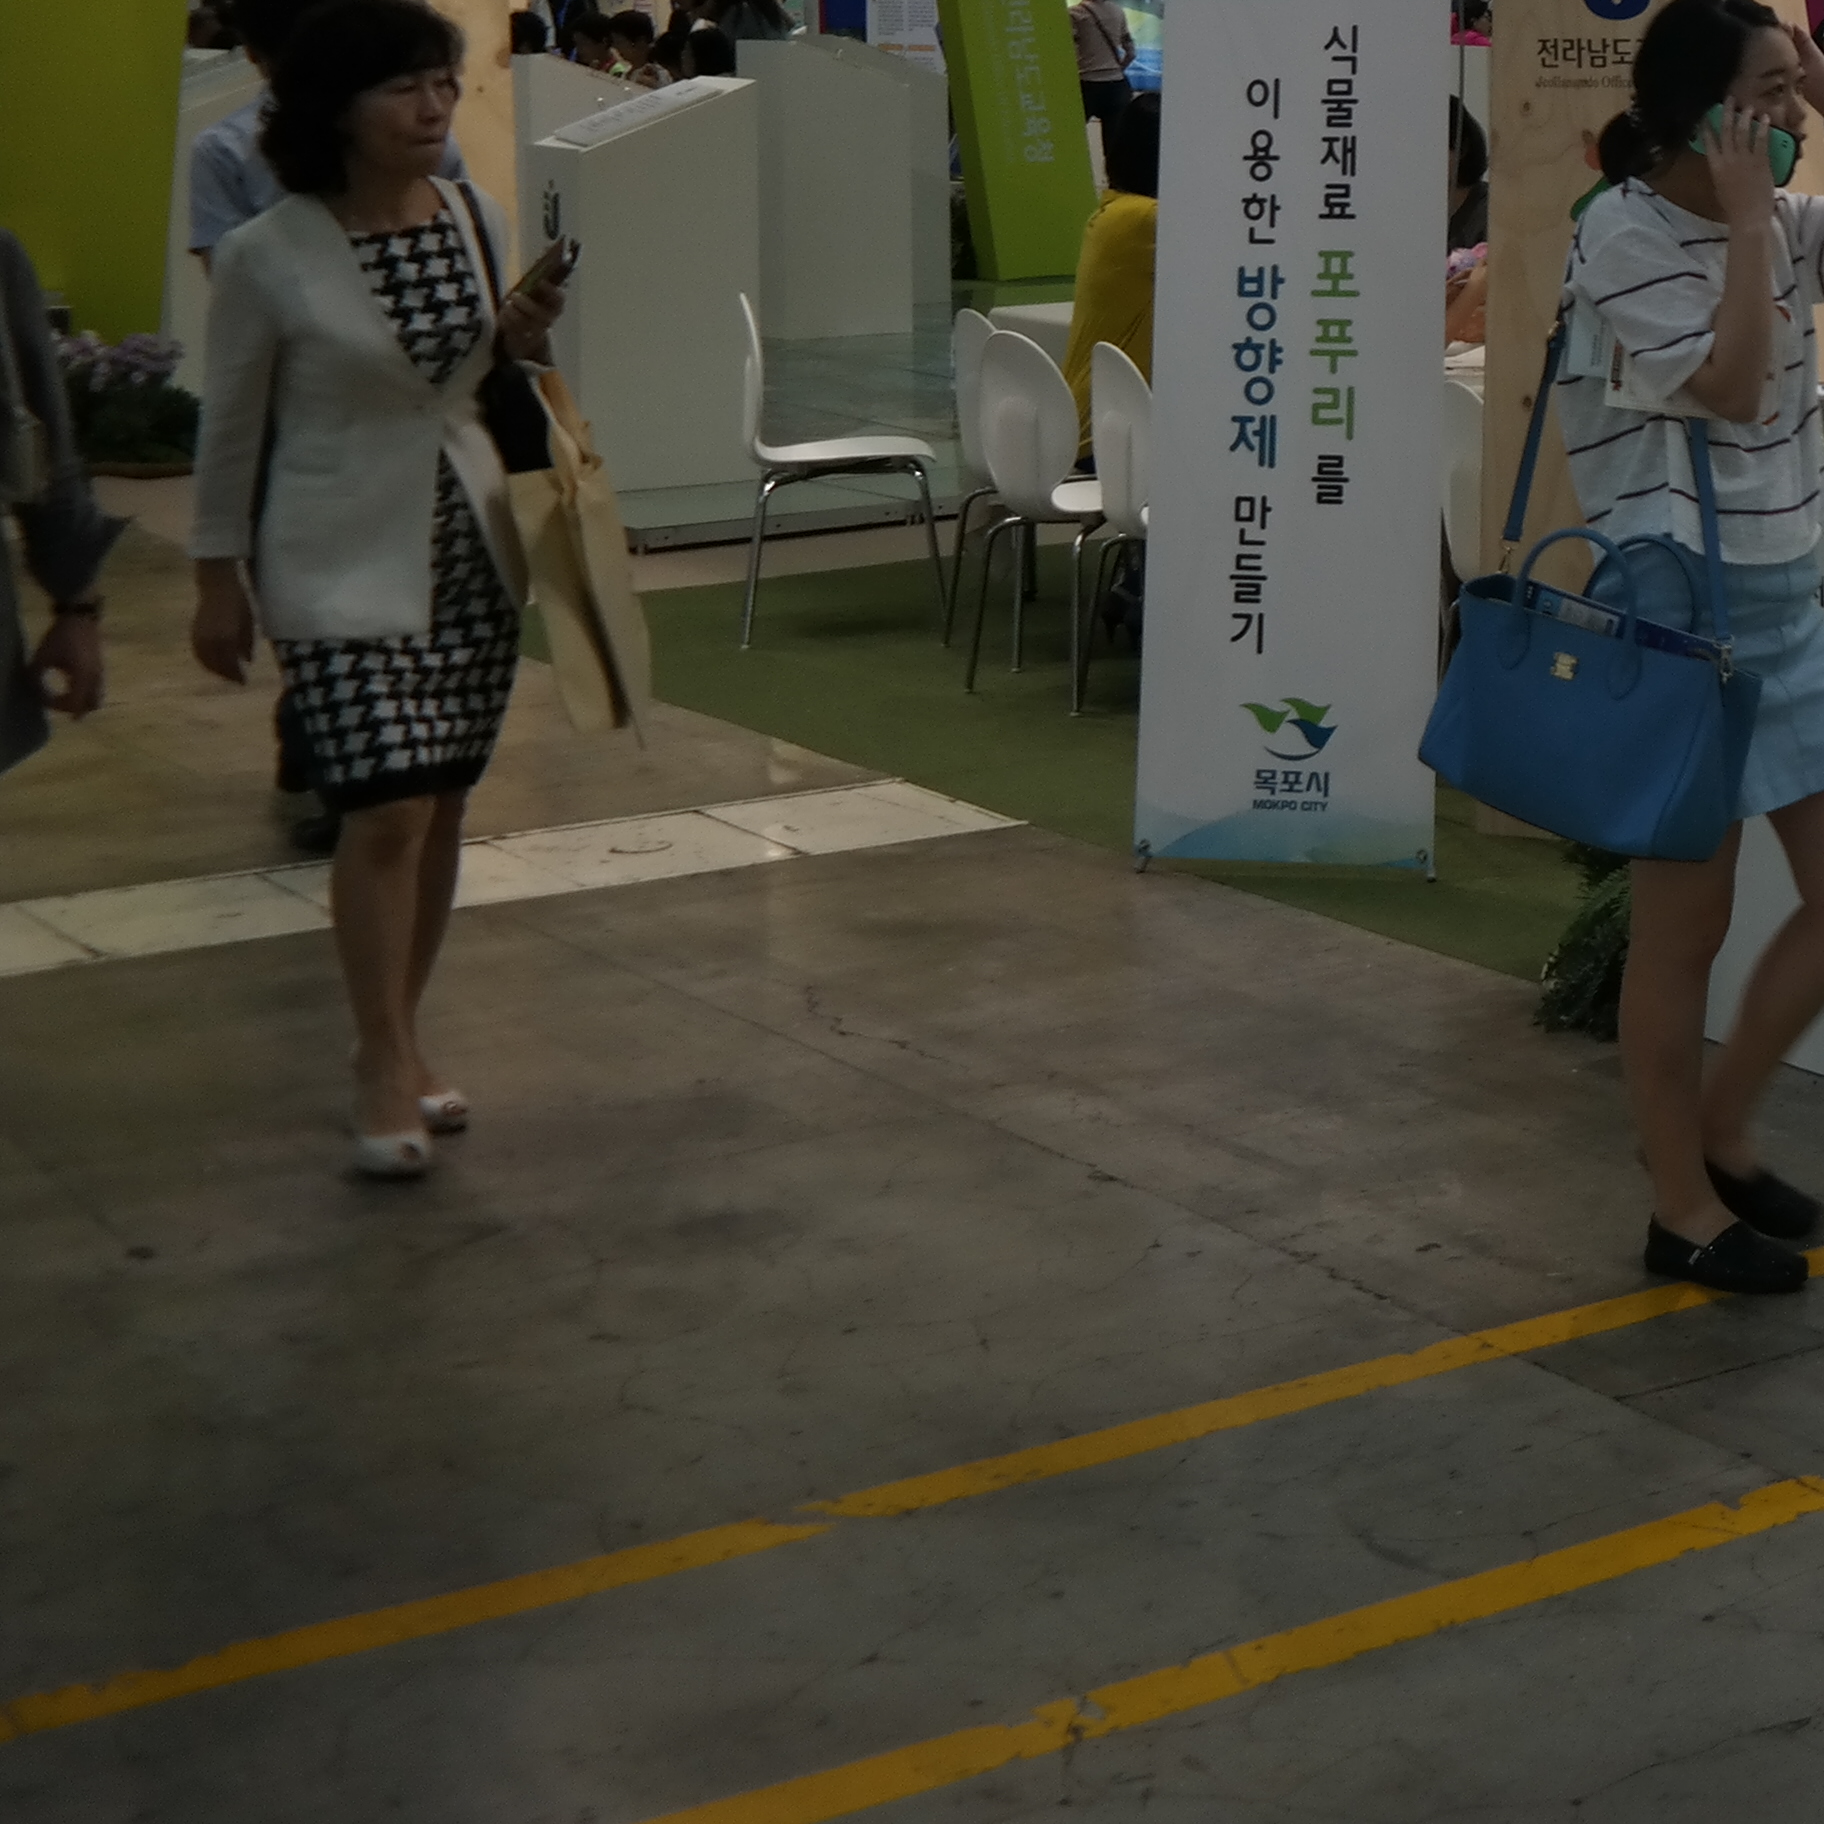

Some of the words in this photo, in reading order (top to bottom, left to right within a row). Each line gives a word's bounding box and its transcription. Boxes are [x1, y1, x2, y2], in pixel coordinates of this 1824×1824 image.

[1317, 24, 1359, 221] 식물재료
[1537, 37, 1646, 69] 전라남도
[1241, 77, 1282, 245] 이용한
[1229, 263, 1286, 470] 방향제
[1229, 495, 1273, 656] 만들기
[1252, 769, 1331, 799] 목포시
[1252, 798, 1298, 812] MOKPO
[1301, 799, 1329, 813] CITY
